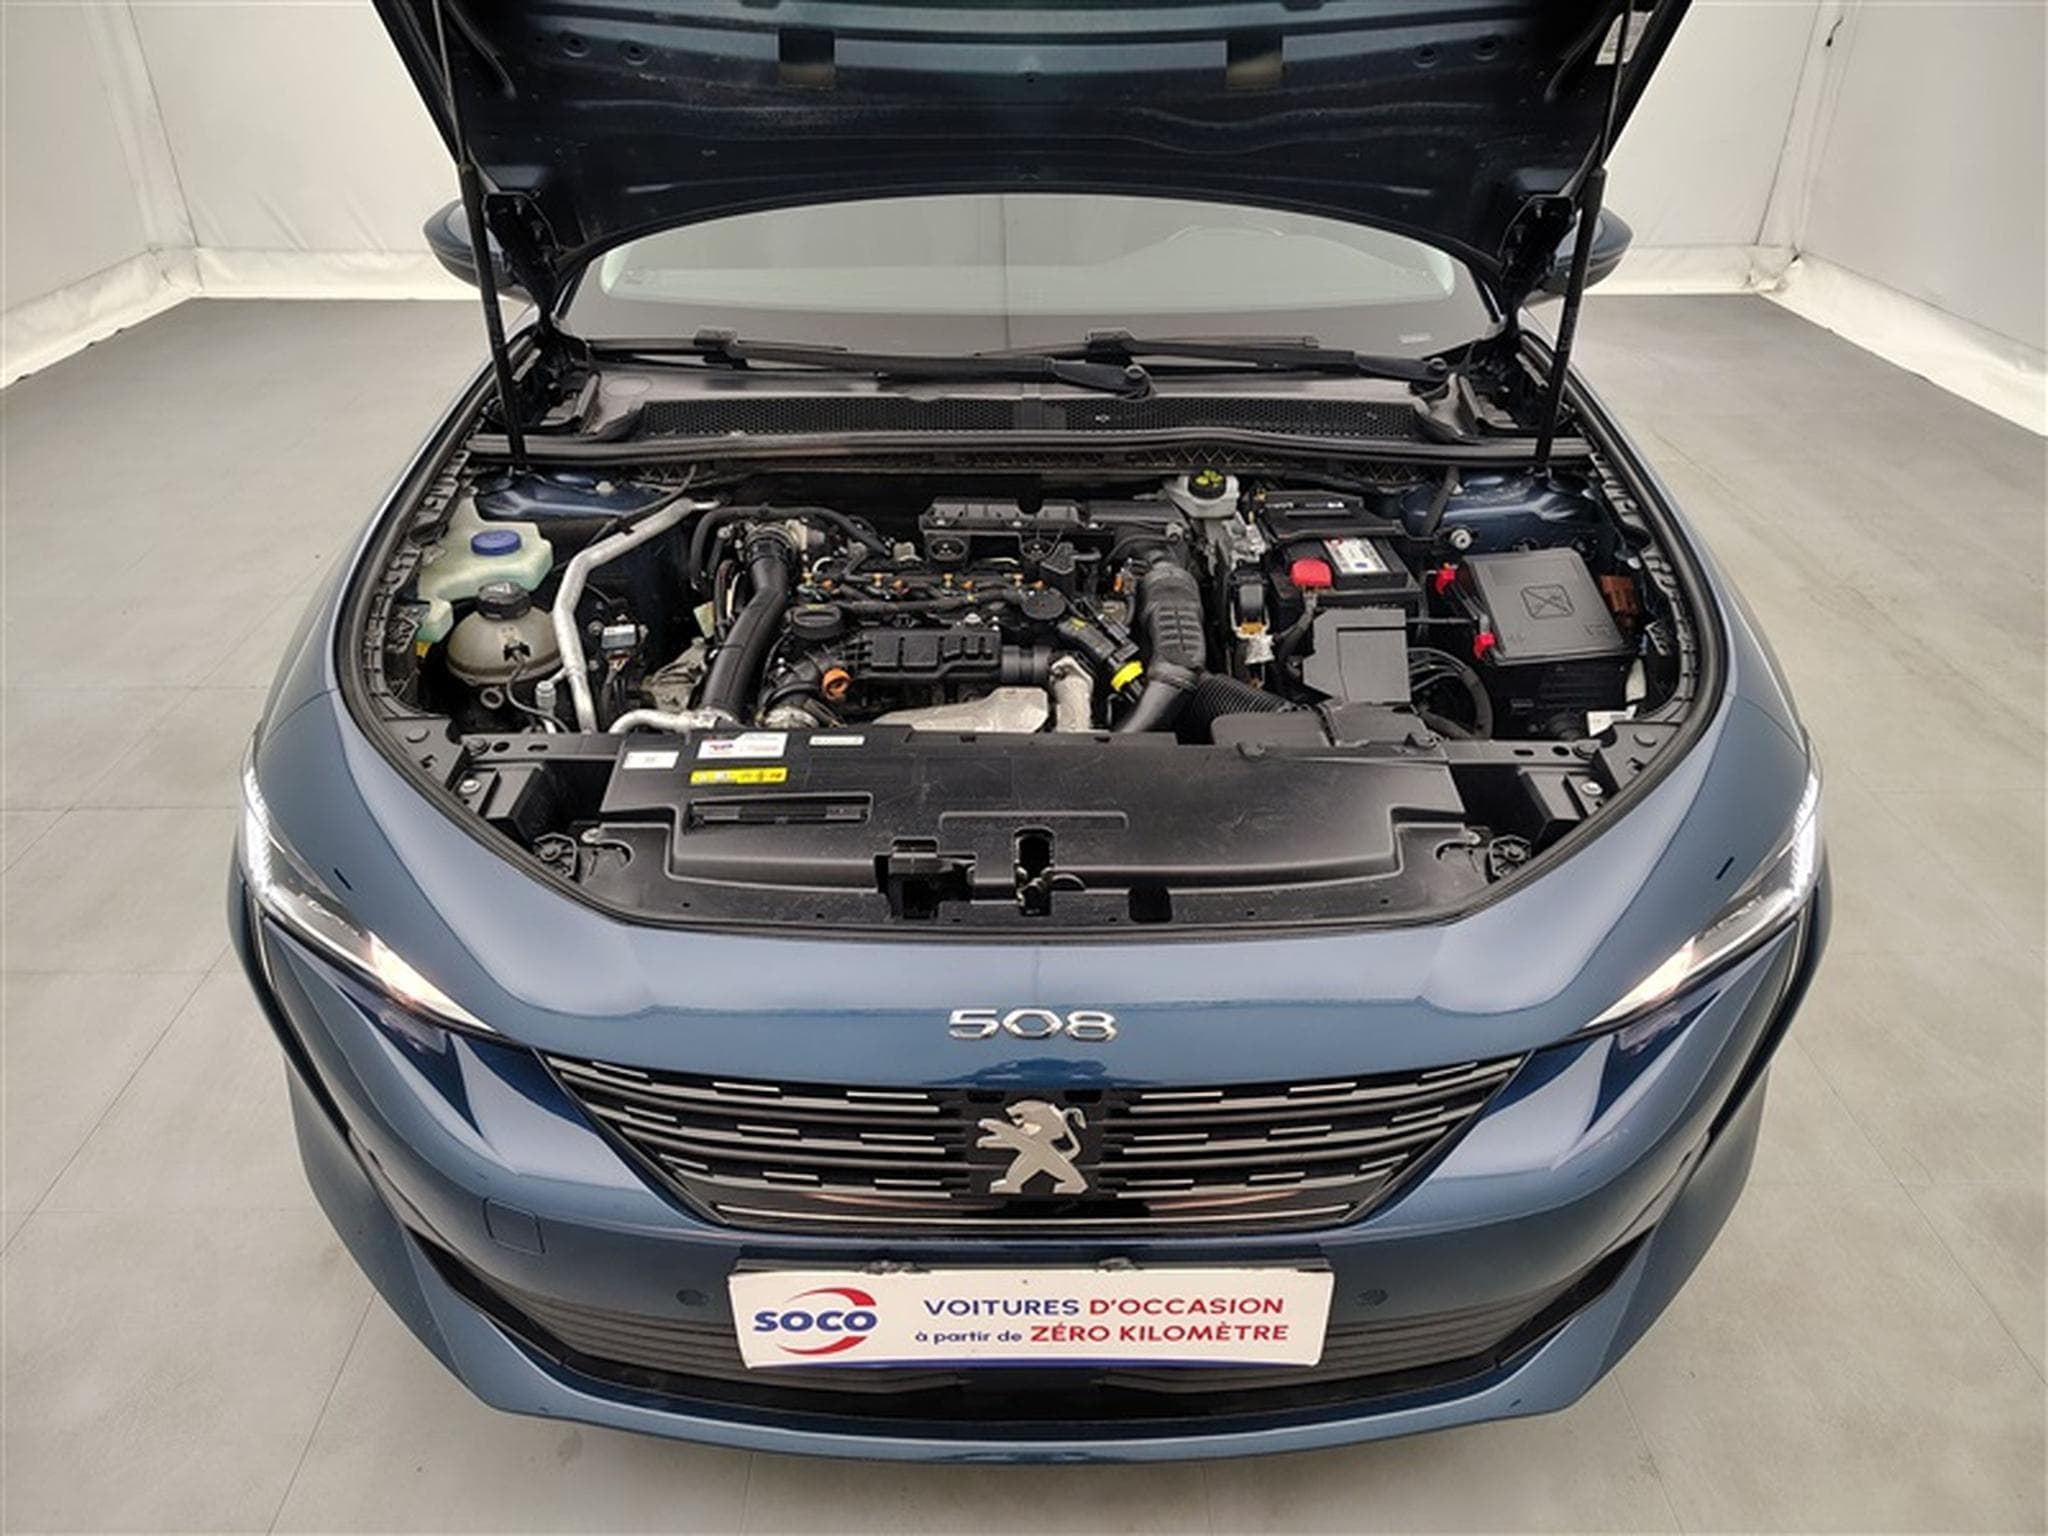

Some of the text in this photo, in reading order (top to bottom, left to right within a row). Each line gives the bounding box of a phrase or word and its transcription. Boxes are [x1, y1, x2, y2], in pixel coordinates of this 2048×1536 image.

[948, 1008, 1118, 1042] 508
[923, 1297, 1285, 1316] VOITURES D'OCCASION
[752, 1310, 878, 1332] SOCO
[914, 1320, 1290, 1346] à partir de ZÉRO KILOMÈTRE
